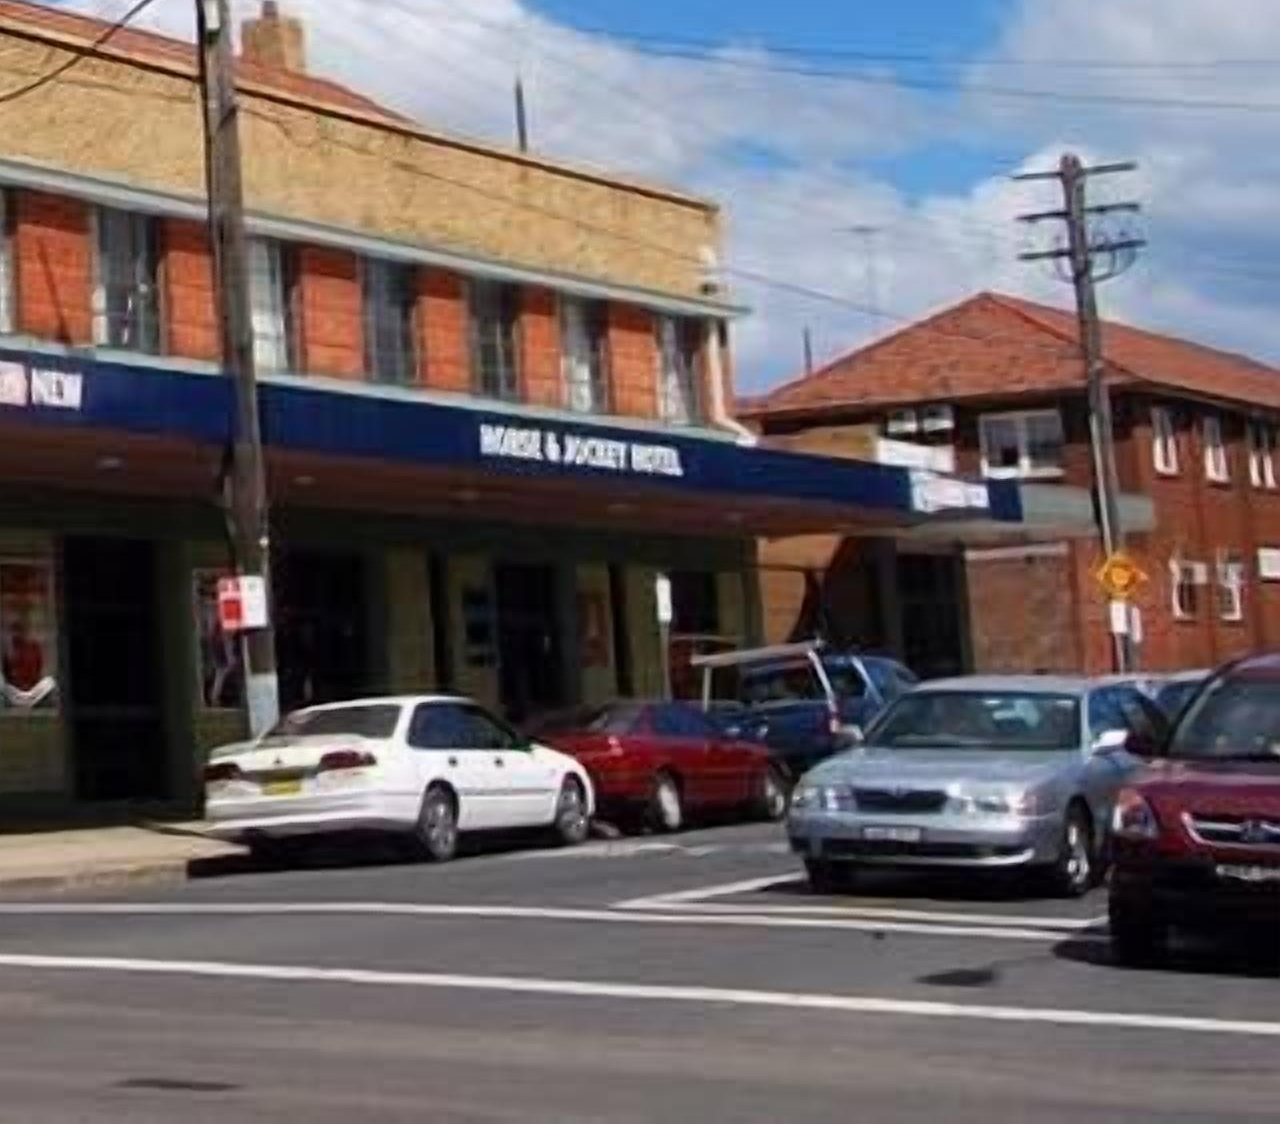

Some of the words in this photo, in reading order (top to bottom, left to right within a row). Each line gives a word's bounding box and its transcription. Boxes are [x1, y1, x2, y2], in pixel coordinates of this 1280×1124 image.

[31, 367, 83, 411] NEW
[479, 423, 544, 461] HORSE
[563, 433, 627, 469] JOCKEY
[630, 442, 684, 477] HOTEL
